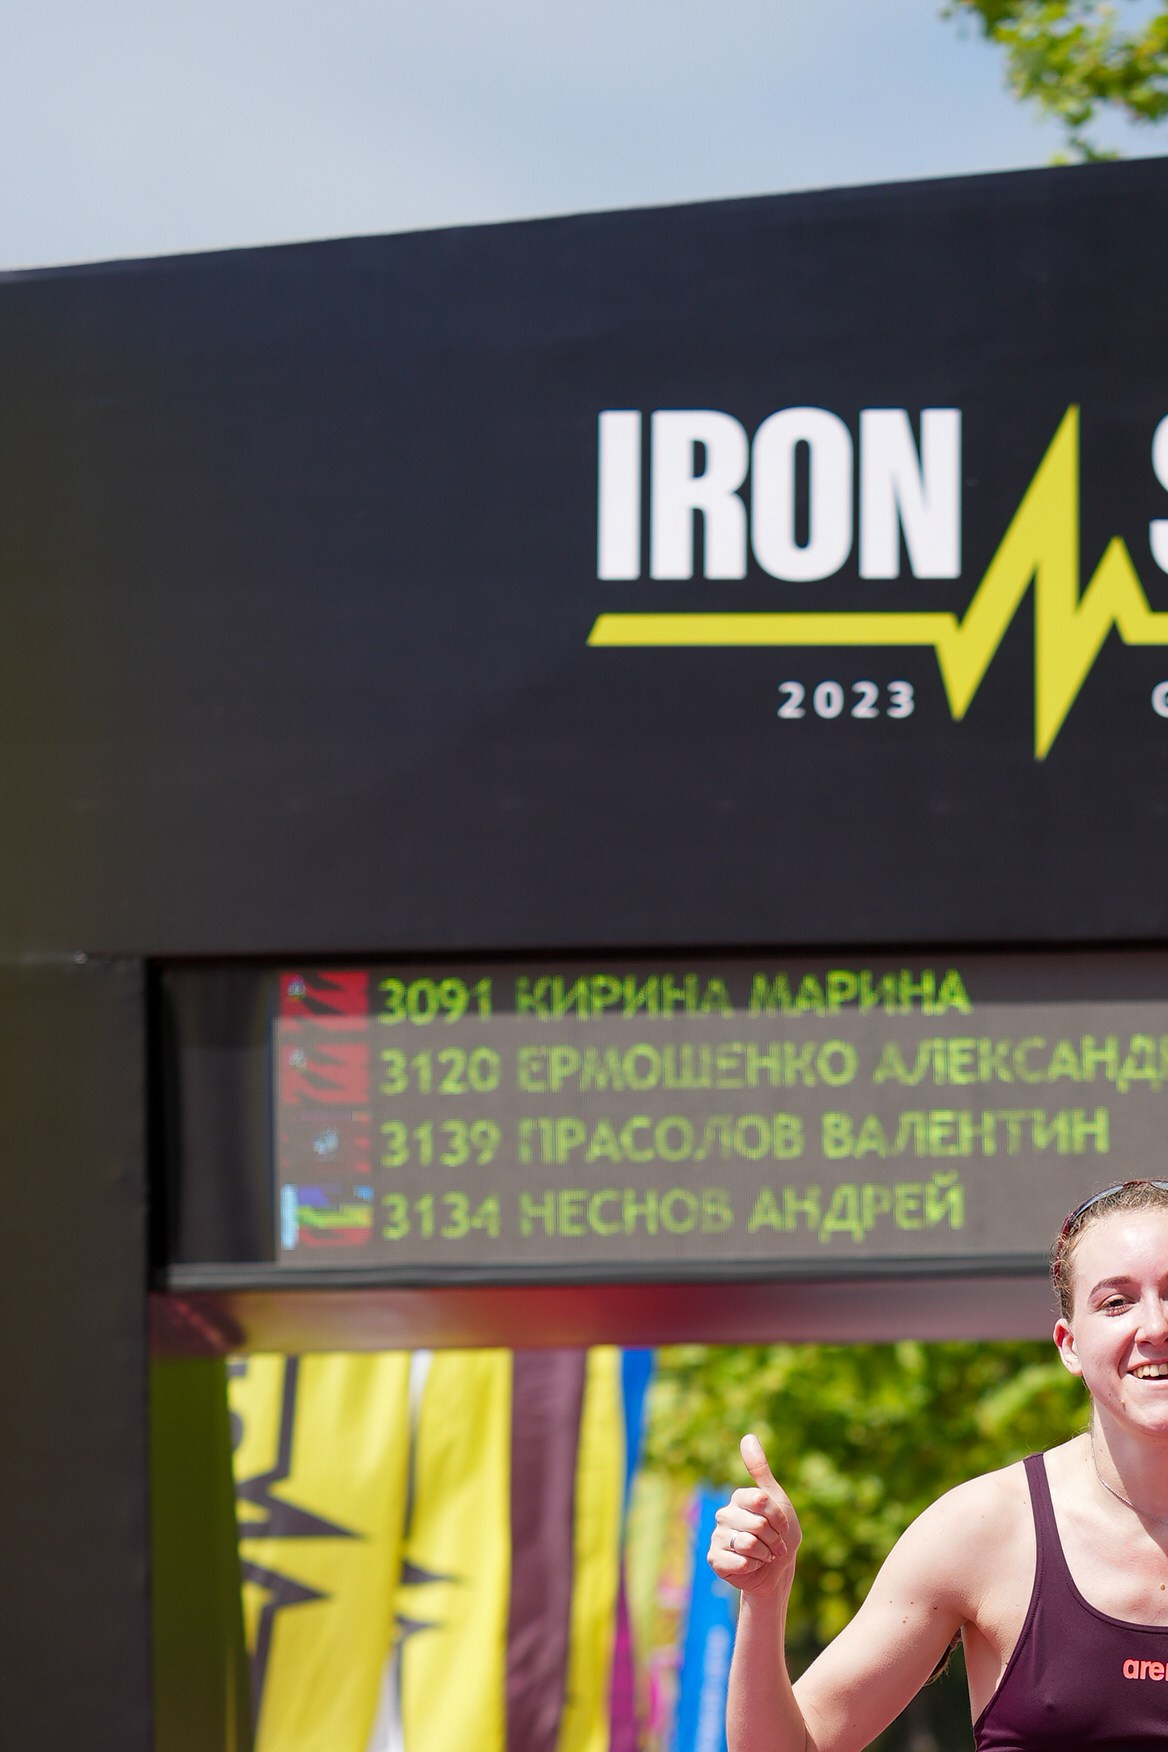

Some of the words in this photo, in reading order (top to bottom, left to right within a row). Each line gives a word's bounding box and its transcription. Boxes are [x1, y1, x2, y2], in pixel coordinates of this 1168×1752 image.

[597, 405, 962, 582] IRON
[777, 680, 916, 720] 2023
[377, 977, 494, 1025] 3091
[517, 974, 731, 1021] КИРИНА
[748, 970, 972, 1018] МАРИНА
[381, 1047, 500, 1098] 3120
[518, 1040, 857, 1095] ЕРМОШЕНКО
[381, 1118, 500, 1170] 3139
[518, 1112, 802, 1166] ПРАСОЛОВ
[822, 1107, 1110, 1160] ВАЛЕНТИН
[382, 1191, 500, 1241] 3134
[519, 1187, 734, 1238] НЕСНОВ
[748, 1173, 966, 1243] АНДРЕЙ
